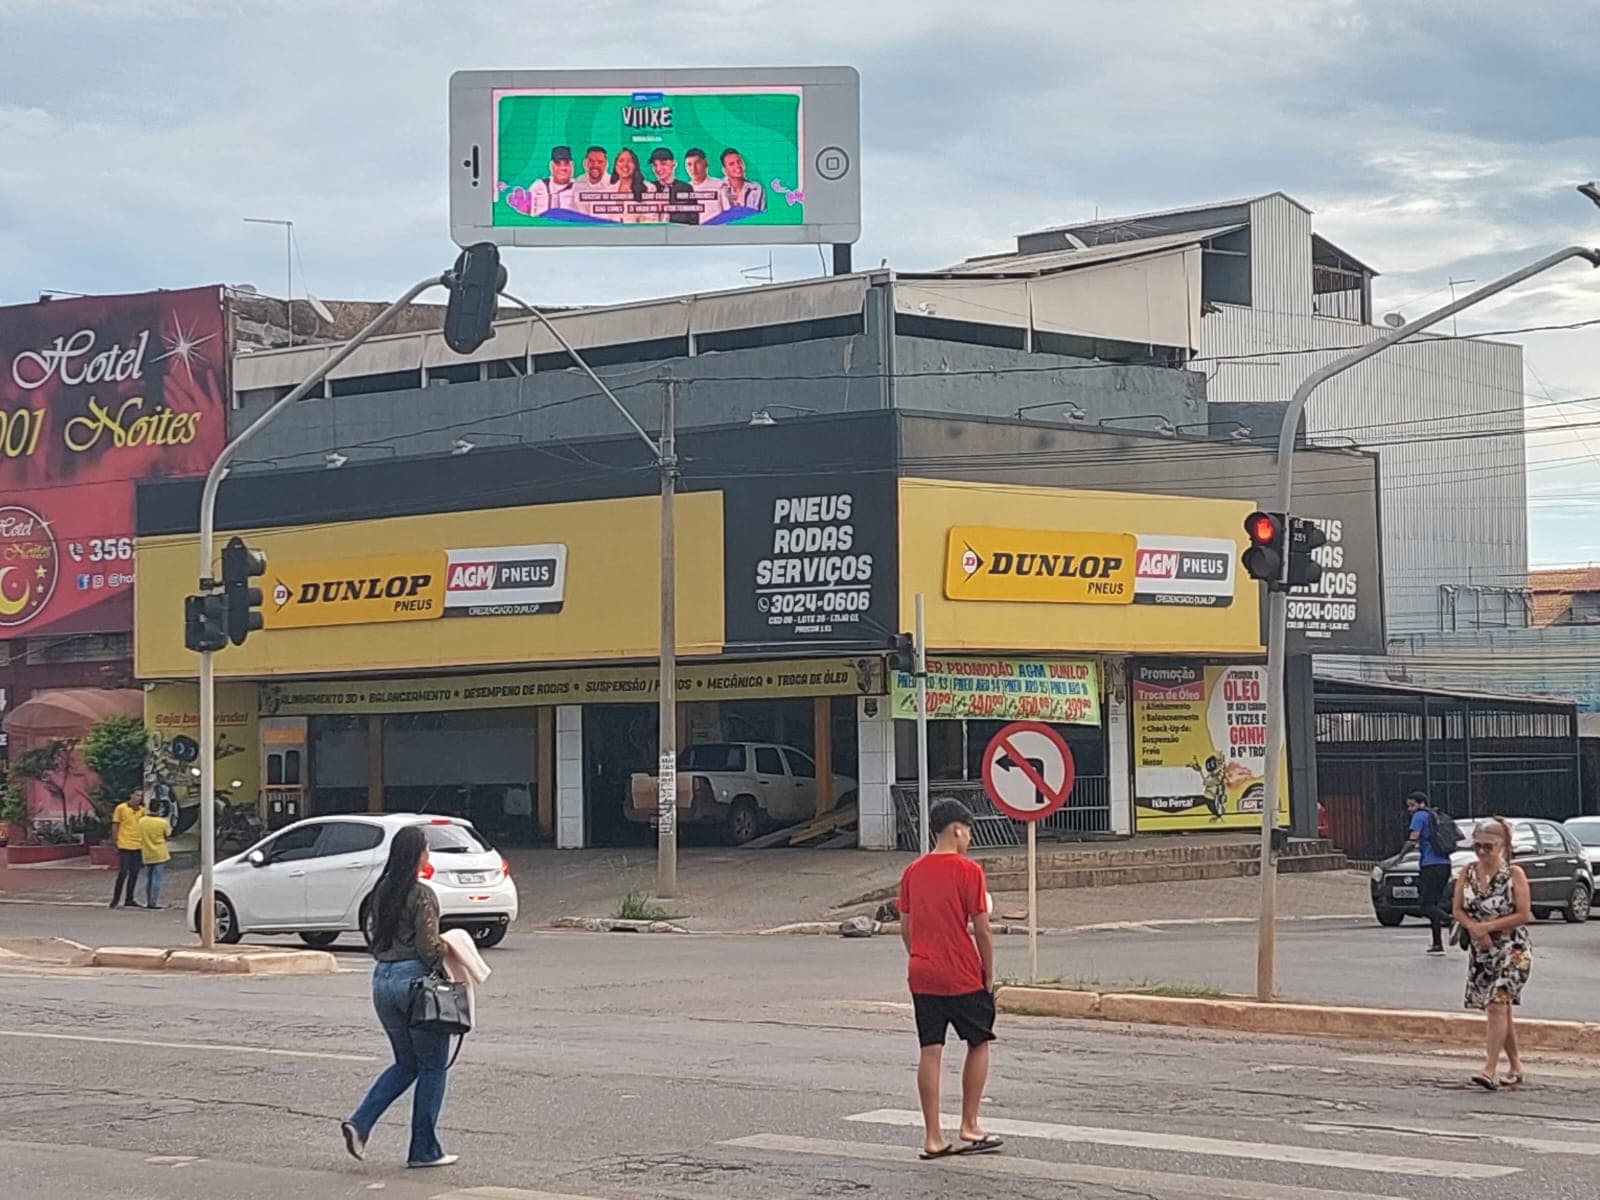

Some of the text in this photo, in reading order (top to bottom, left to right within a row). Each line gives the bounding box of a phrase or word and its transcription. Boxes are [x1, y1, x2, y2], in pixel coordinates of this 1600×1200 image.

[12, 329, 149, 389] Hotel
[64, 396, 202, 452] Noites
[773, 494, 852, 524] PNEUS
[89, 537, 136, 561] 356
[773, 525, 854, 554] RODAS
[450, 563, 550, 588] AGM PNEUS
[756, 555, 873, 587] SERVIÇOS
[988, 553, 1122, 579] DUNLOP
[1138, 552, 1224, 576] AGM PNEUS
[297, 575, 431, 604] DUNLOP
[1087, 582, 1124, 594] PNEUS
[394, 599, 432, 612] PNEUS
[770, 592, 870, 613] 3024-0606
[1287, 602, 1357, 621] 3024-0606
[522, 683, 536, 695] DE
[777, 672, 808, 687] TROCA
[809, 672, 822, 685] DE
[823, 669, 848, 683] ÓLEO
[1140, 666, 1195, 683] Promoção
[1139, 685, 1200, 700] Troca de Óleo
[182, 712, 201, 724] be
[1234, 713, 1260, 725] VEZES
[1229, 726, 1267, 745] GANH
